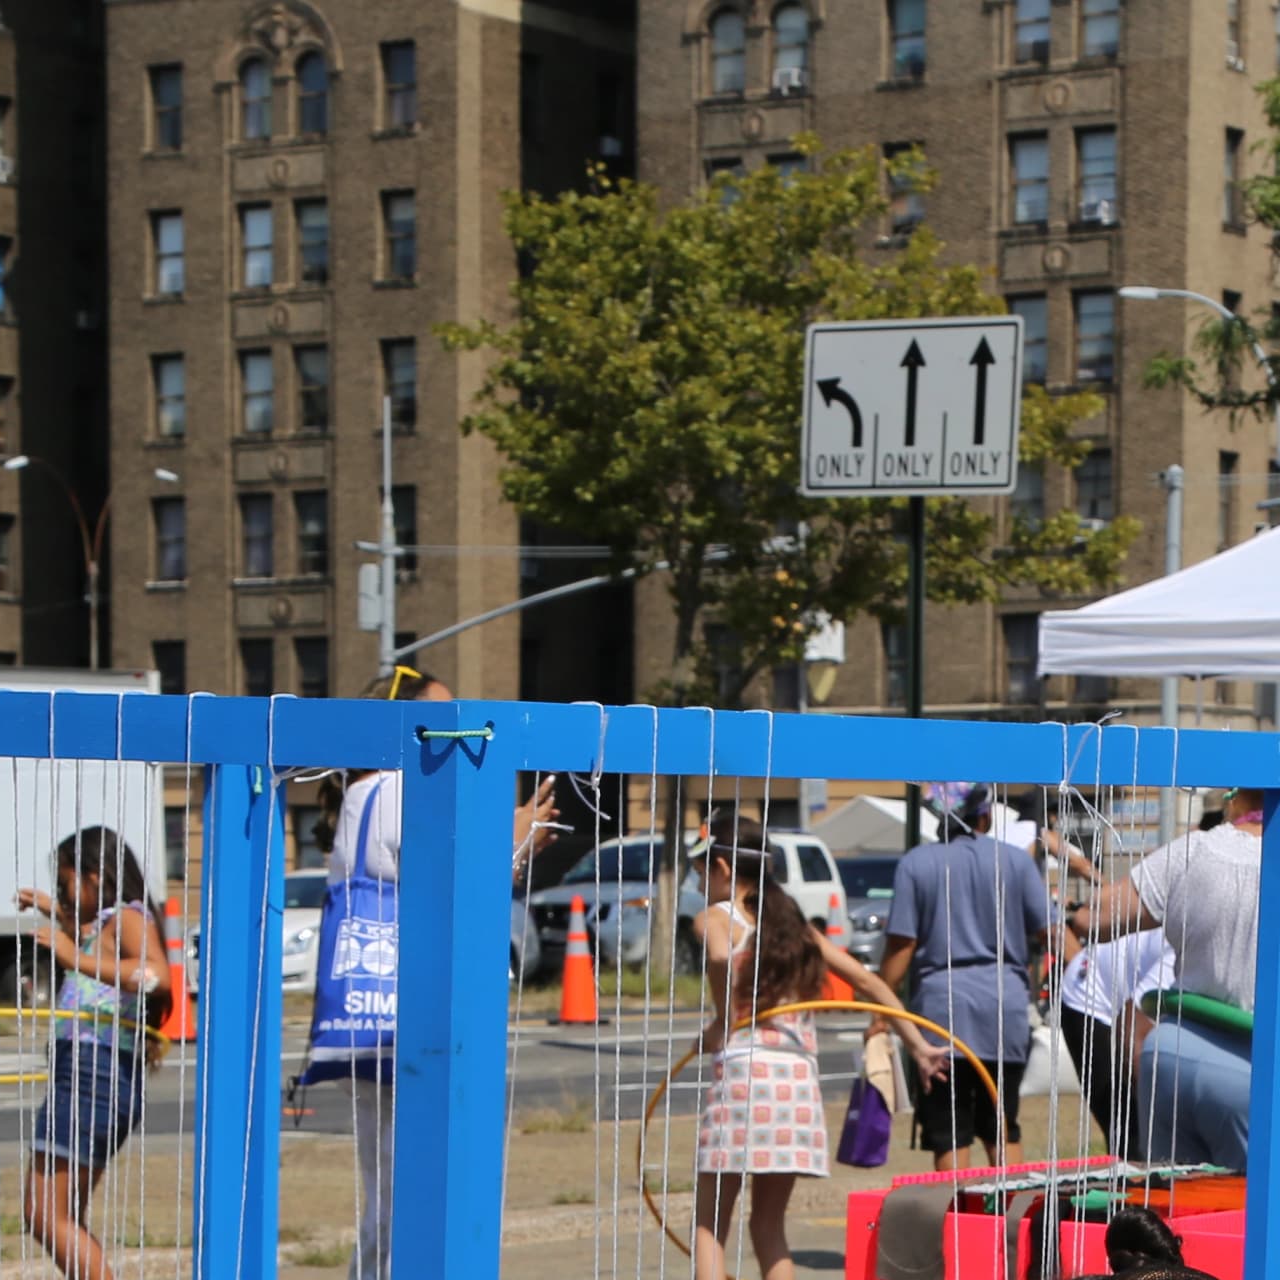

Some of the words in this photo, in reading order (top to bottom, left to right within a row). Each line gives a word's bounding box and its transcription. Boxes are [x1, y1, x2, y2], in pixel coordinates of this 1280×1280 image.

[816, 454, 865, 478] ONLY
[883, 453, 933, 477] ONLY
[950, 452, 1001, 476] ONLY
